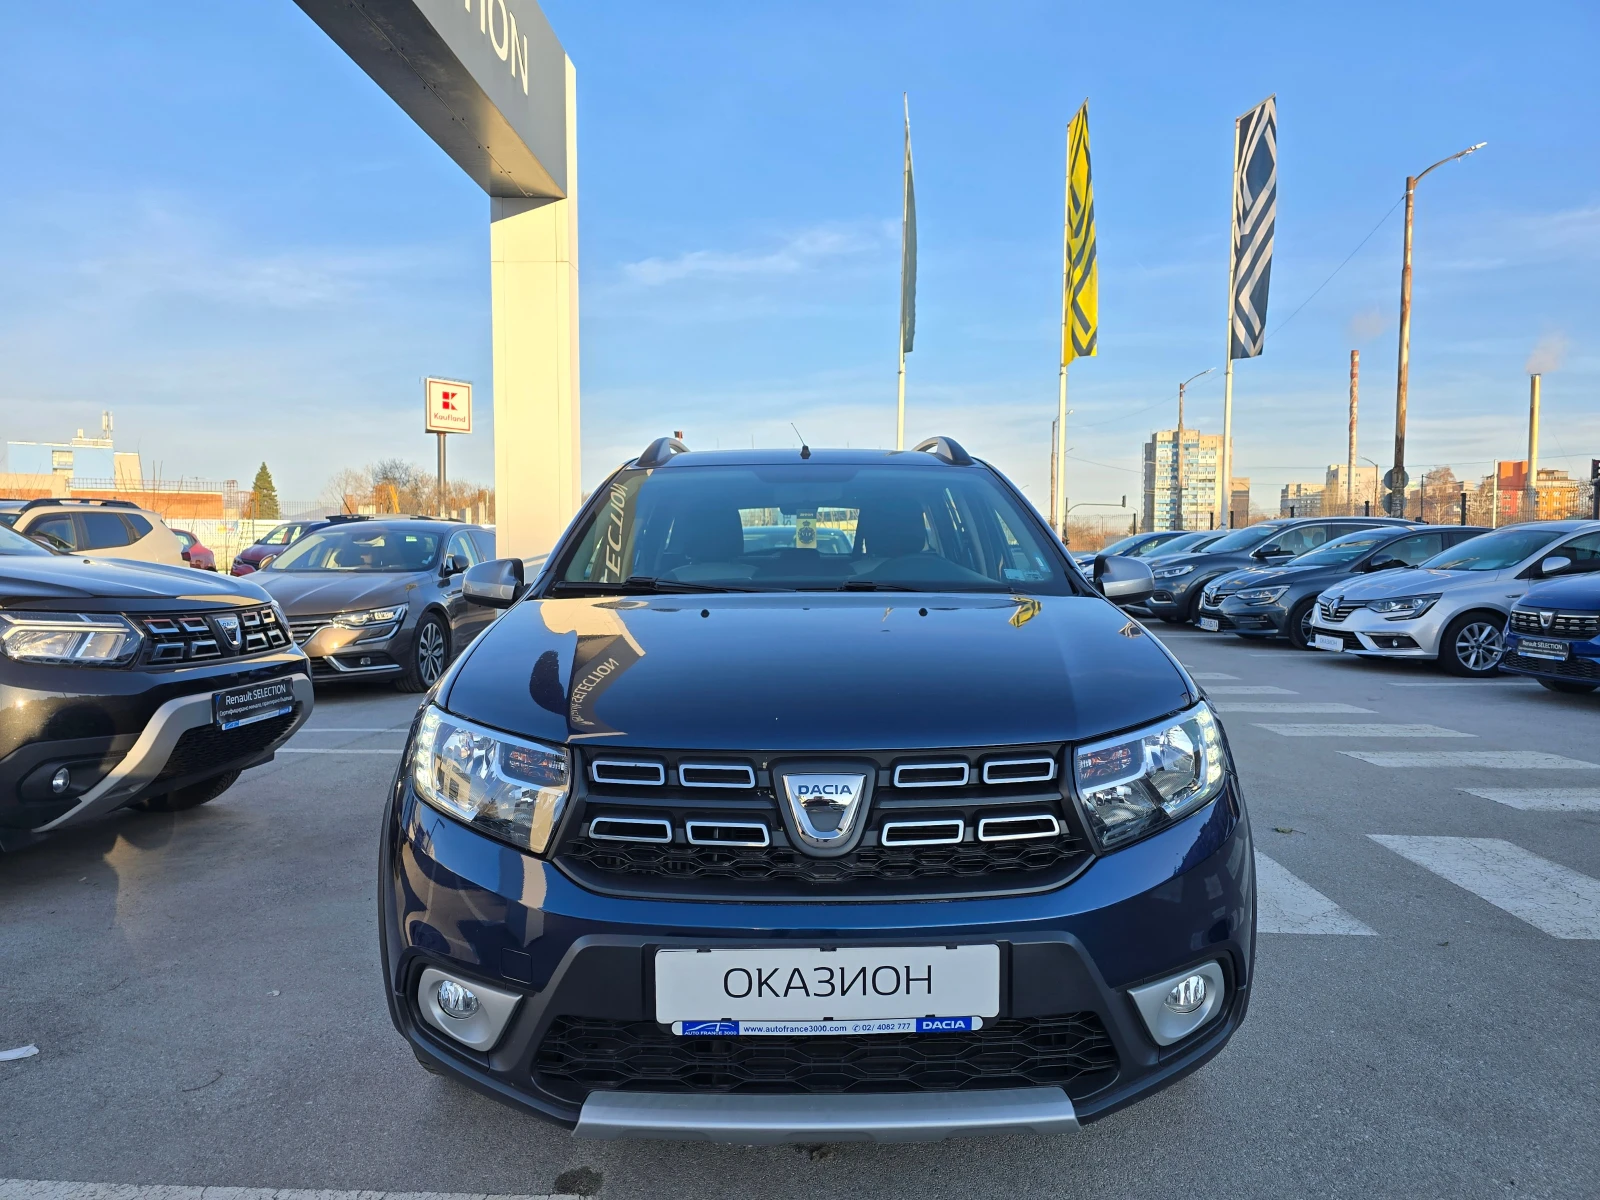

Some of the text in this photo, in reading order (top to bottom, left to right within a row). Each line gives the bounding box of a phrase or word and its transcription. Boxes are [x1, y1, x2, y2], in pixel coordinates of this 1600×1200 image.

[433, 412, 466, 423] Kaufland
[1537, 641, 1563, 650] SELECTION
[225, 684, 286, 705] Renault SELECTION
[797, 784, 853, 795] DACIA
[723, 965, 932, 998] ОКАЗИОН
[743, 1025, 847, 1033] www.autofrance3000.com
[862, 1024, 874, 1032] 02/
[877, 1023, 896, 1031] 4082
[922, 1020, 966, 1030] DACIA
